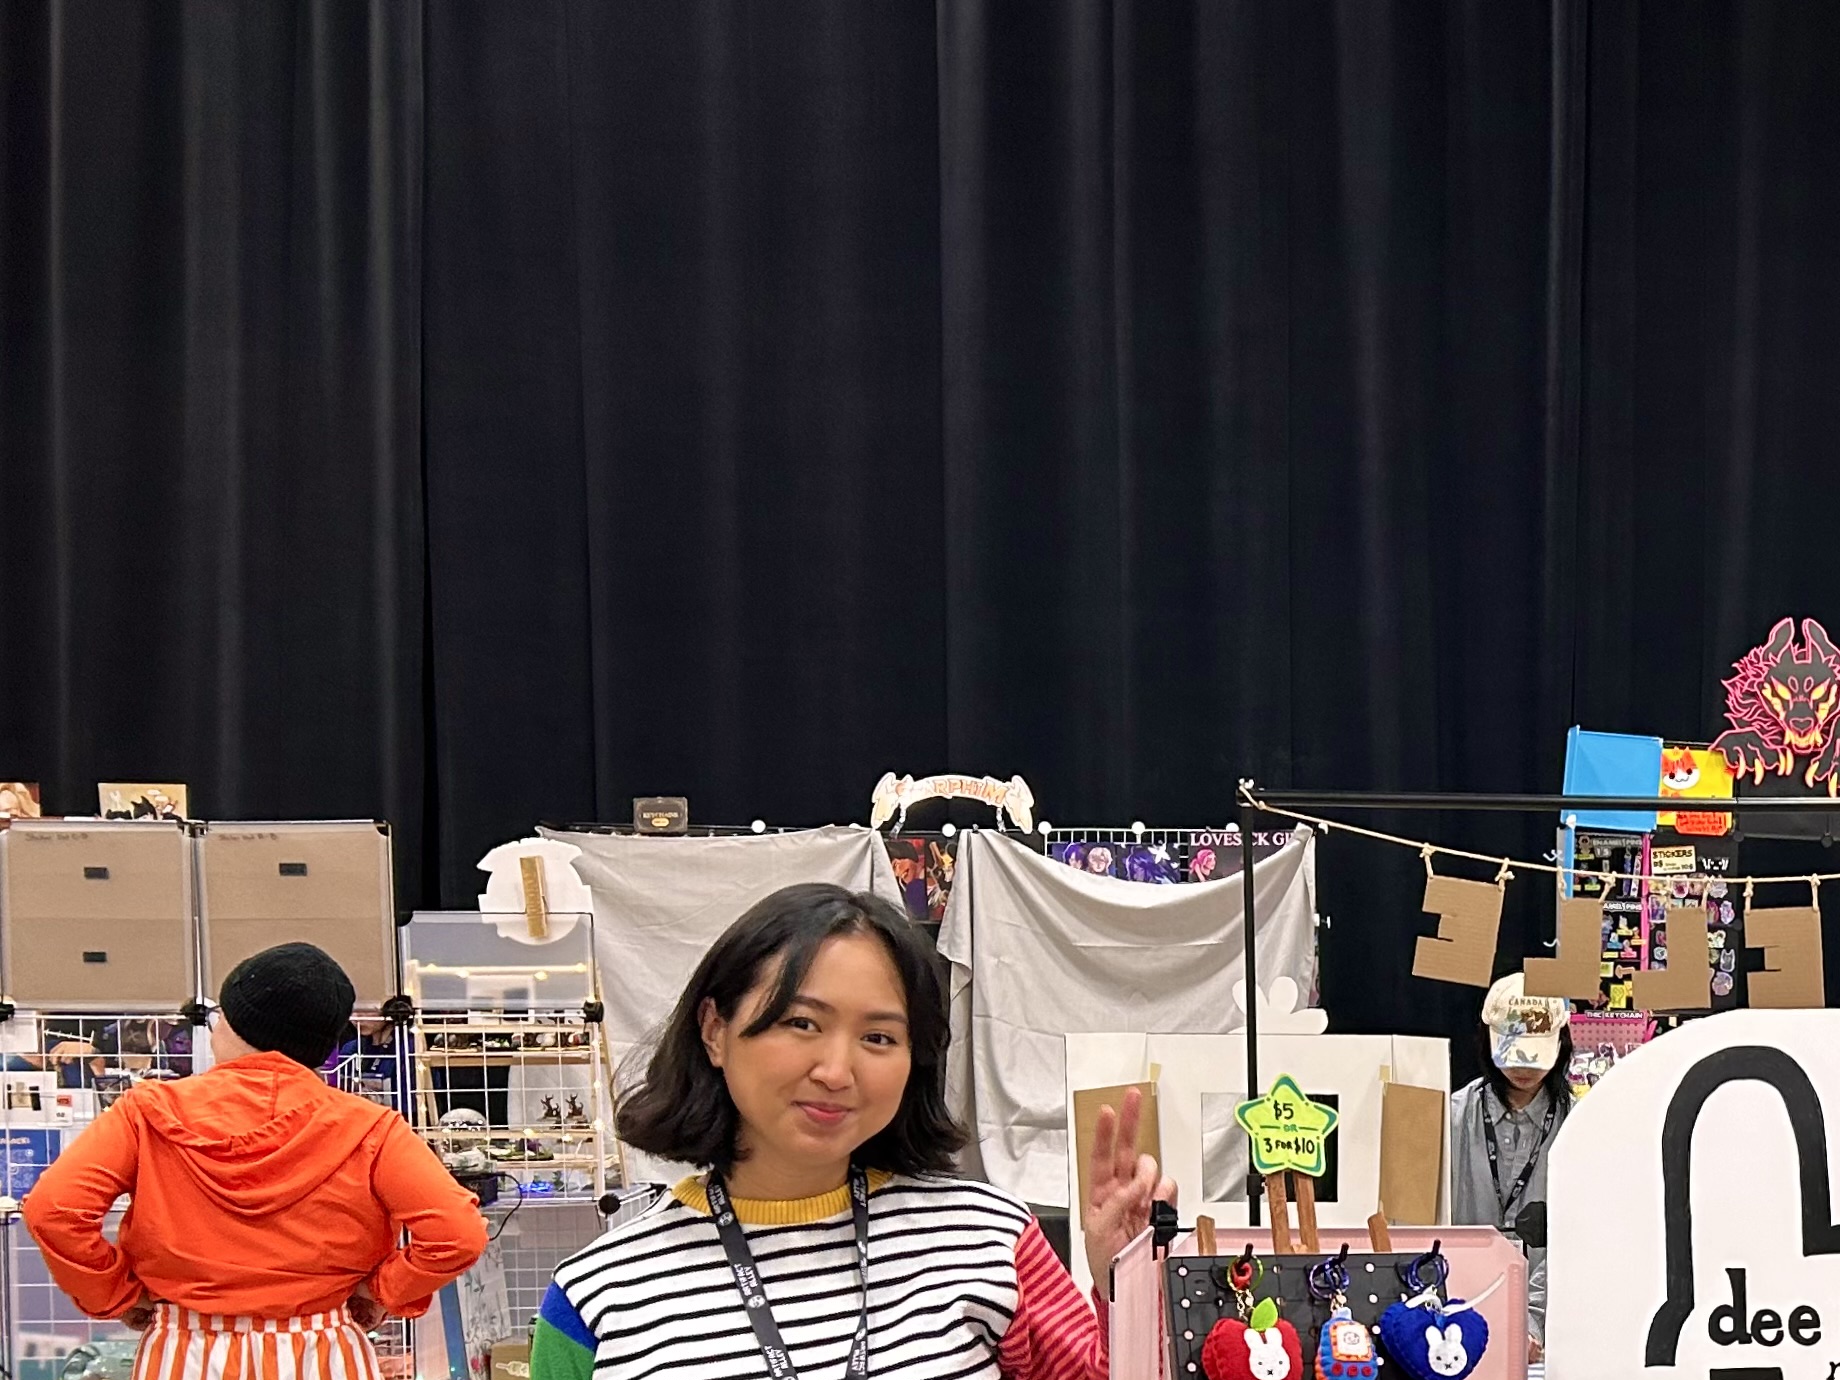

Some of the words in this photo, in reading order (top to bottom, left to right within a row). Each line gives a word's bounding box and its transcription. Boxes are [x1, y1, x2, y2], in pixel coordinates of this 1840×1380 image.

[1190, 832, 1271, 847] LOVESCK
[1508, 998, 1543, 1007] CANADA
[1273, 1099, 1294, 1121] $5
[1263, 1137, 1273, 1153] 3
[1275, 1139, 1294, 1150] FOR
[1294, 1136, 1315, 1155] $10
[1708, 1267, 1822, 1346] dee
